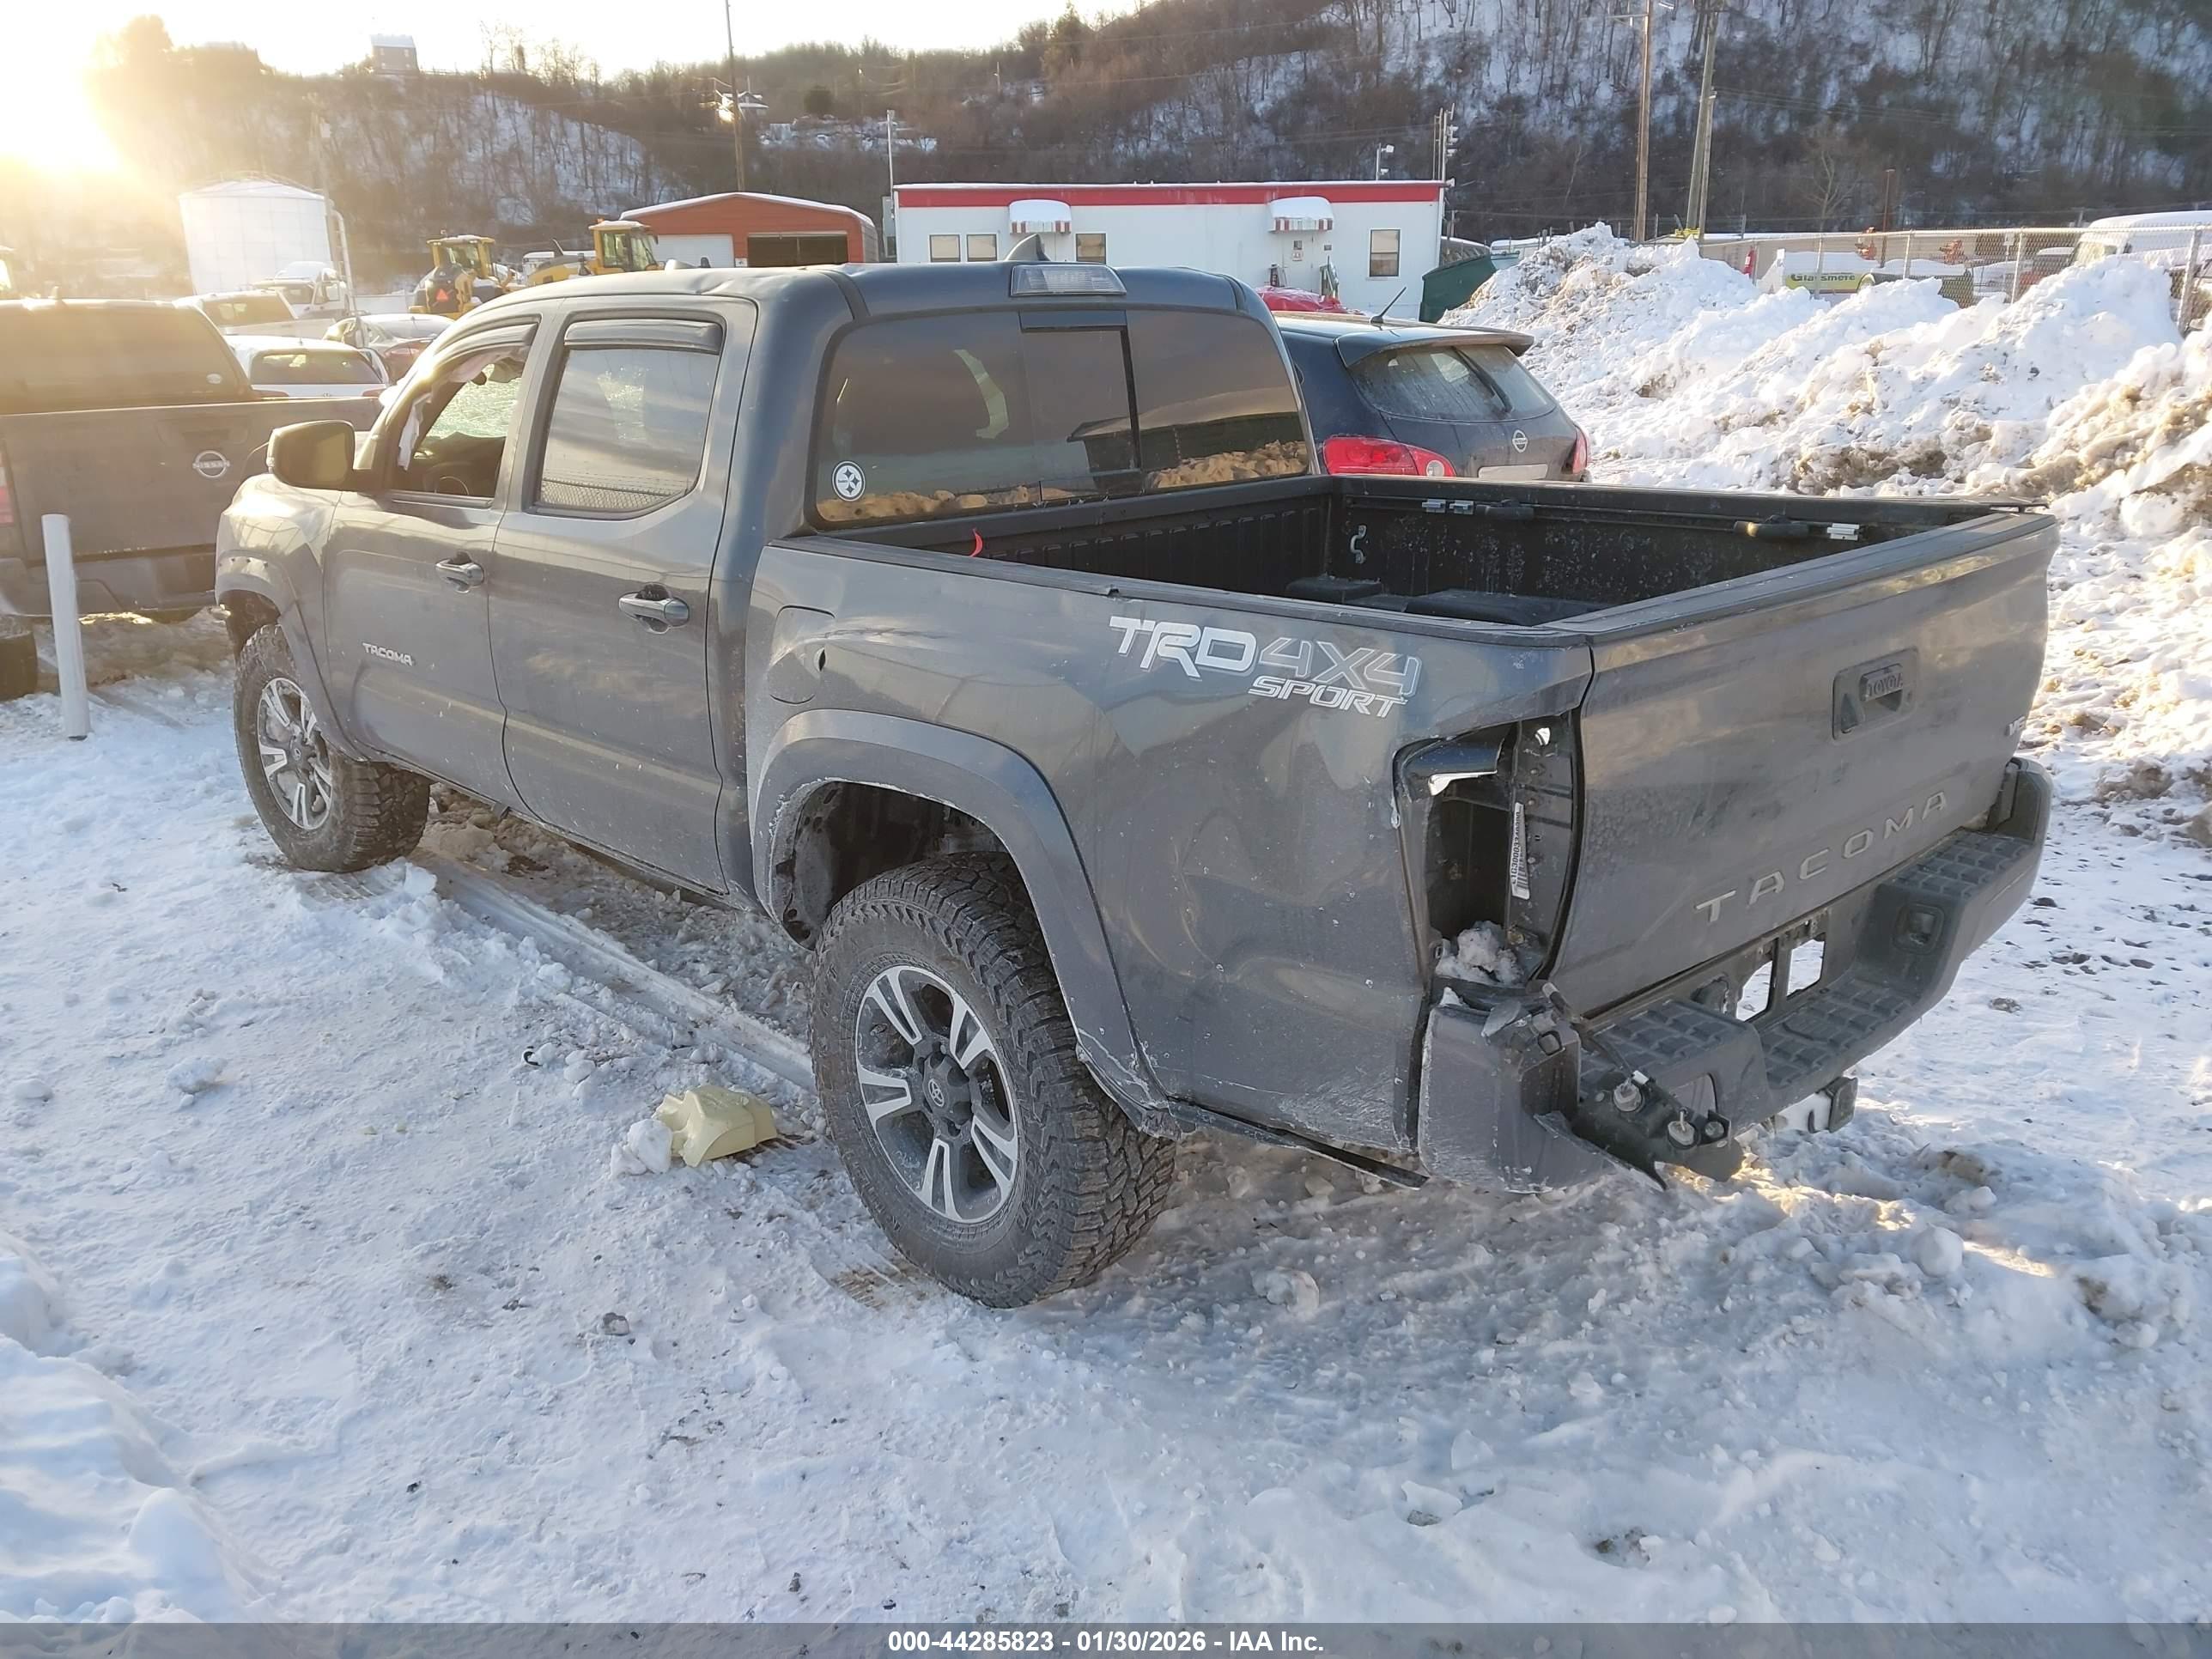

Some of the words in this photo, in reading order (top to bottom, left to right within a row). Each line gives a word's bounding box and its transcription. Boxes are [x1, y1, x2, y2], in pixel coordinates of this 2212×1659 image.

[1790, 273, 1856, 282] Glasmere
[362, 641, 413, 667] TACOMA
[1109, 616, 1258, 679] TRD
[1258, 637, 1423, 697] 4X4
[1248, 675, 1409, 718] SPORT
[1694, 790, 1948, 923] TACOMA
